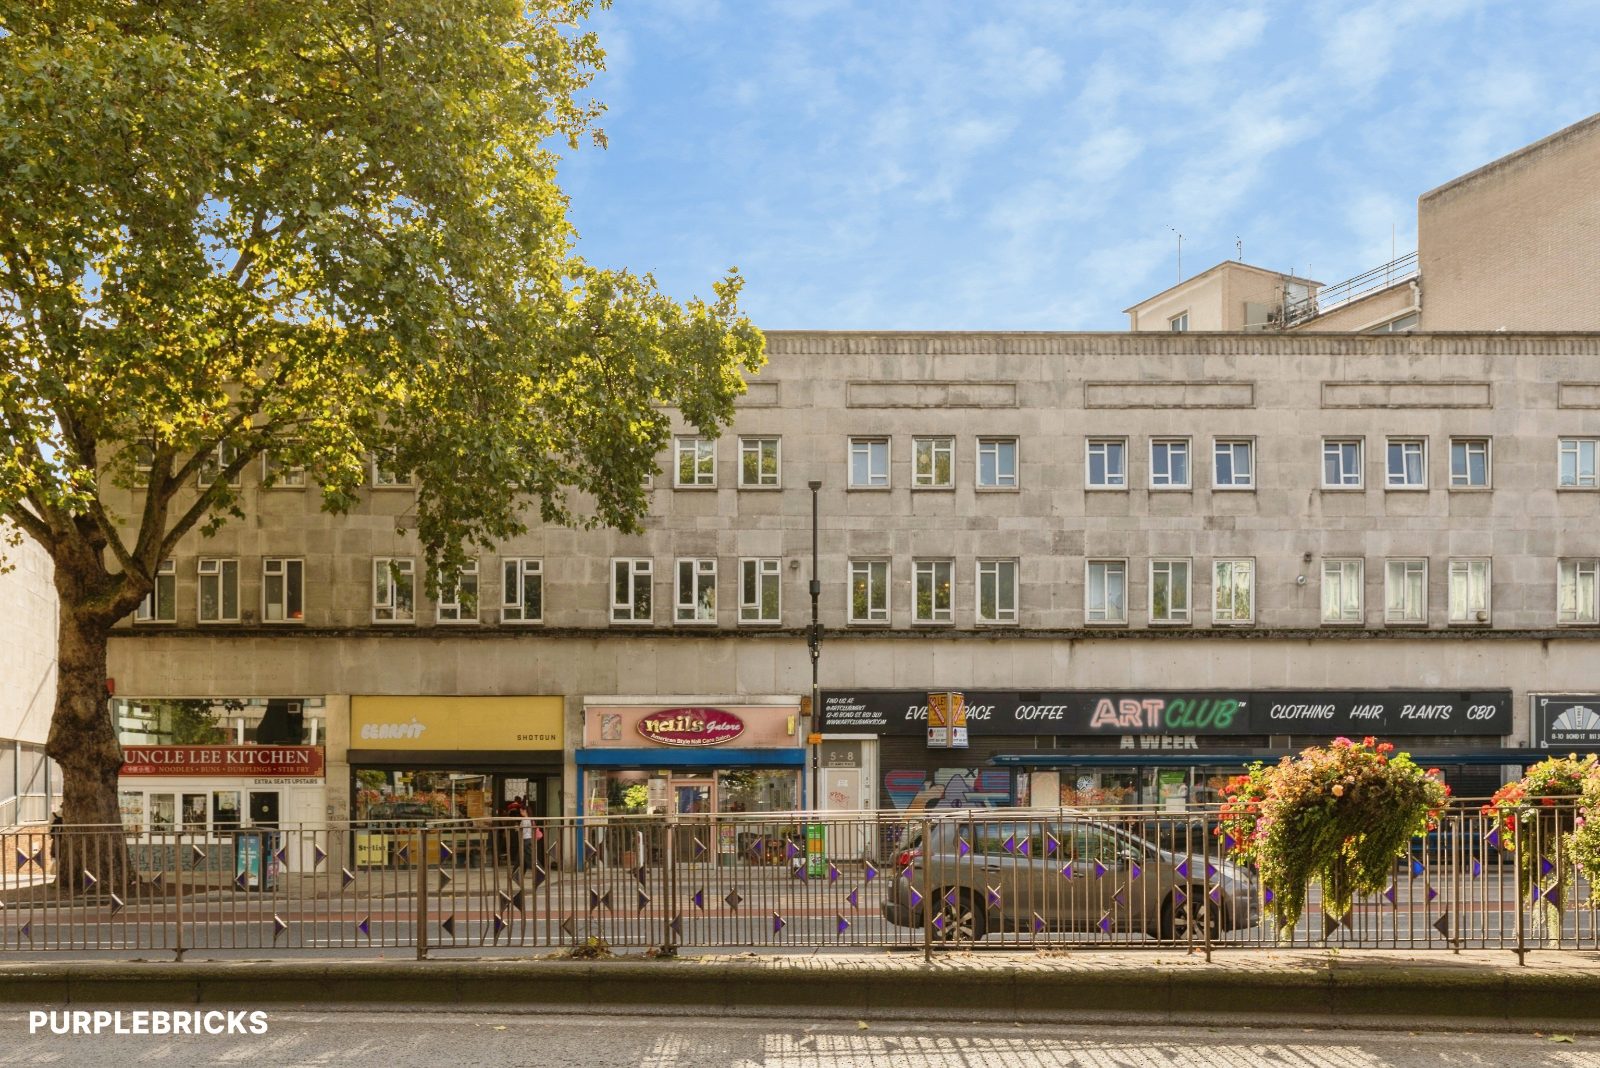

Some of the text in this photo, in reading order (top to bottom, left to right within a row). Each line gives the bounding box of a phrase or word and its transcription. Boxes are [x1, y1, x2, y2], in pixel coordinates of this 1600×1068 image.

[905, 705, 928, 720] EVE
[963, 705, 995, 720] PACE
[1015, 705, 1068, 720] COFFEE
[1090, 698, 1165, 728] ART
[1164, 698, 1240, 729] CLUB
[1270, 704, 1496, 720] CLOTHING HAIR PLANTS CBD
[644, 715, 741, 733] nails Galore
[651, 733, 677, 743] American
[715, 734, 731, 742] Salon
[1120, 735, 1198, 749] A WEEK
[123, 750, 310, 764] UNCLE LEE KITCHEN
[847, 751, 854, 761] 8
